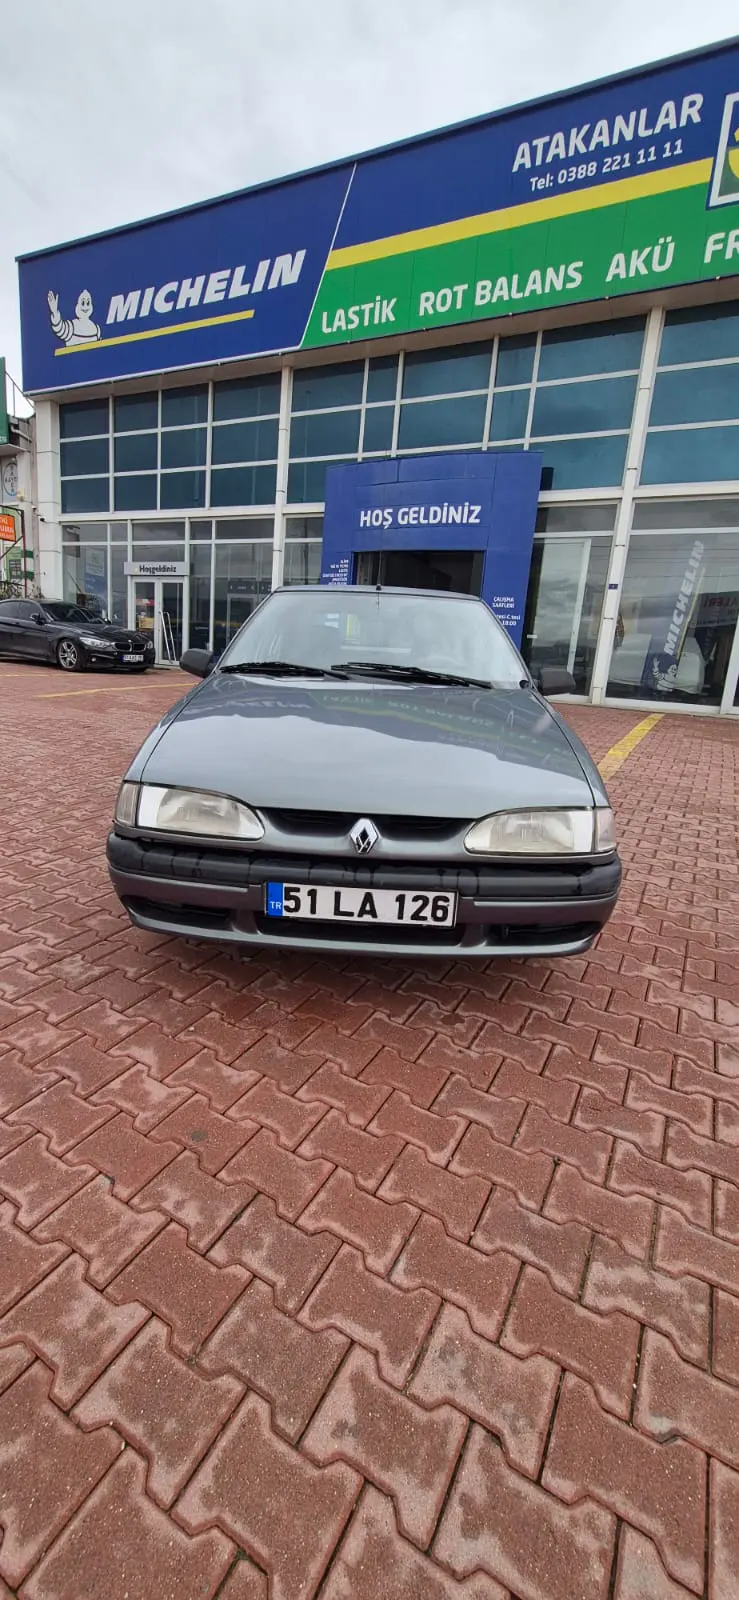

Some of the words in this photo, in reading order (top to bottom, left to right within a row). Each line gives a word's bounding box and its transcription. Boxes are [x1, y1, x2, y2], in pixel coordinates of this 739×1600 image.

[512, 93, 703, 172] ATAKANLAR
[530, 173, 553, 192] Tel:
[558, 163, 596, 184] 0388
[602, 154, 631, 175] 221
[637, 145, 657, 165] 11
[663, 139, 683, 158] 11
[106, 249, 306, 325] MICHELIN
[322, 296, 397, 334] LASTİK
[418, 284, 468, 316] ROT
[475, 261, 583, 307] BALANS
[606, 237, 674, 282] AKÜ
[360, 508, 393, 529] HOŞ
[398, 502, 482, 525] GELDİNİZ
[664, 540, 705, 656] MICHELIN
[283, 886, 318, 915] 51
[333, 890, 378, 919] LA
[394, 893, 450, 923] 126
